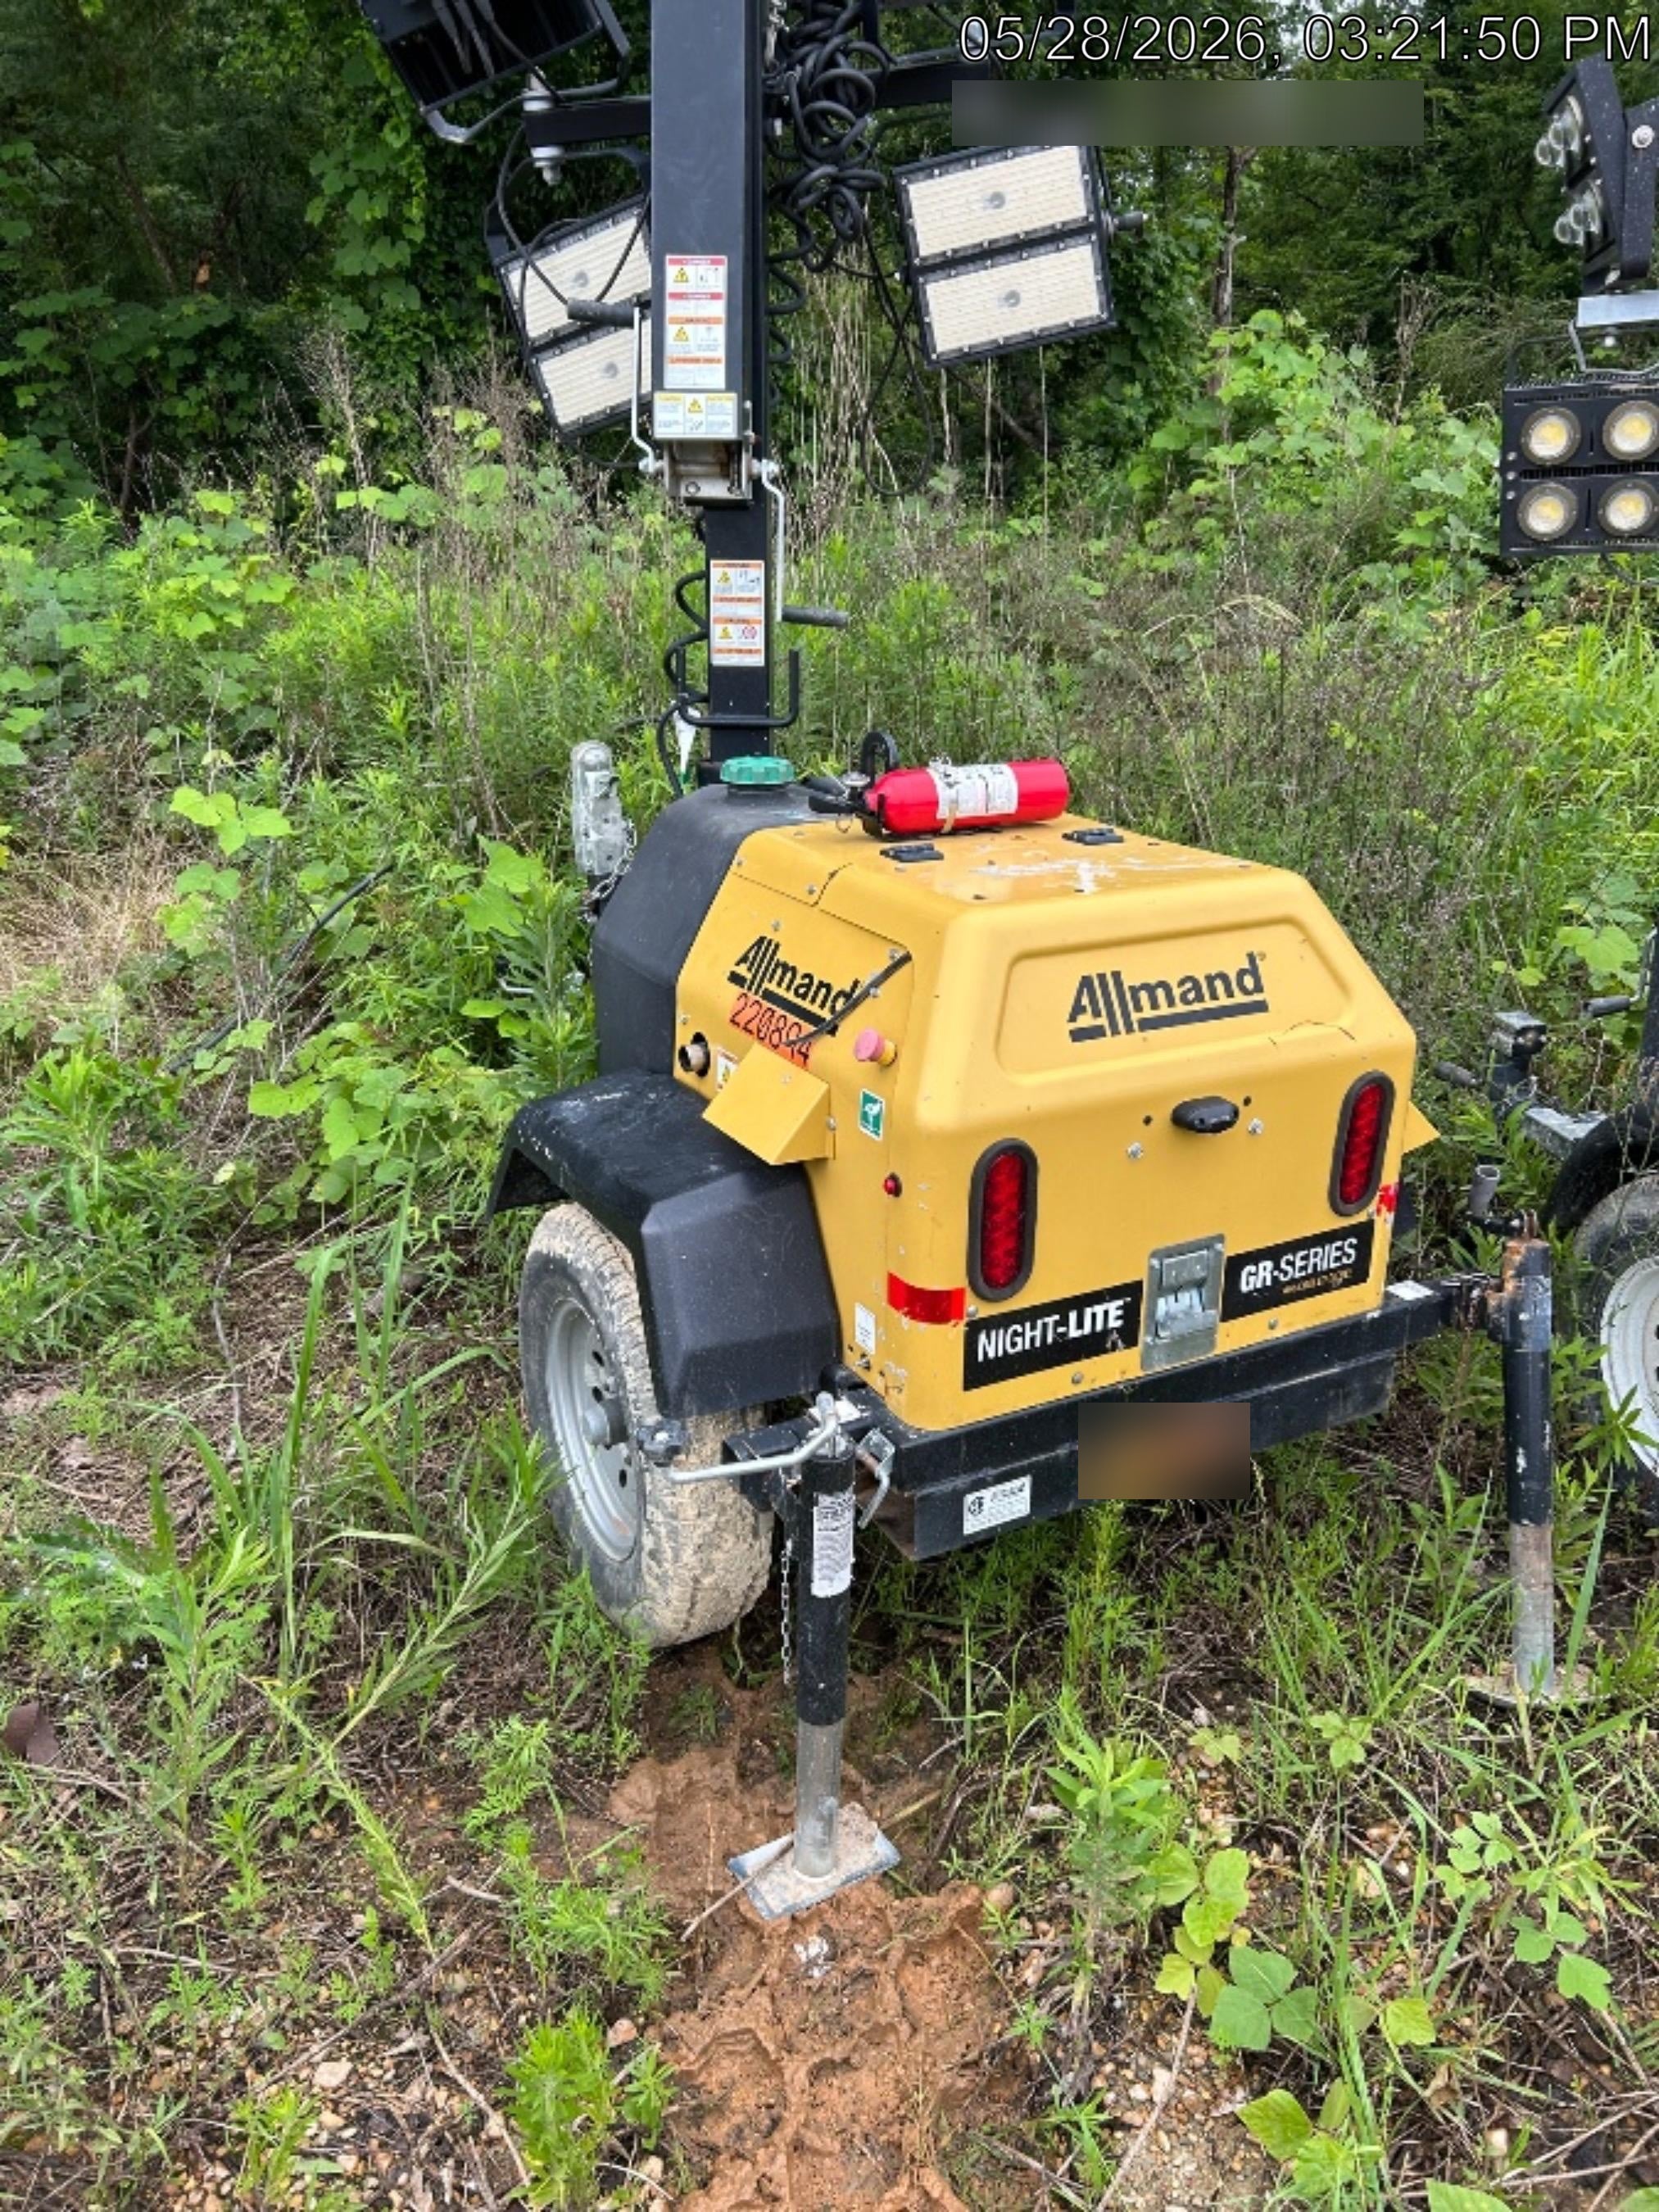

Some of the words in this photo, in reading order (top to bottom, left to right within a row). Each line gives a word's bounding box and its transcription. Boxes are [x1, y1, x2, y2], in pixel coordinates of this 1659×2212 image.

[734, 936, 859, 1015] Allmand
[1067, 951, 1264, 1037] Allmand
[1240, 1238, 1358, 1293] GR-SERIES
